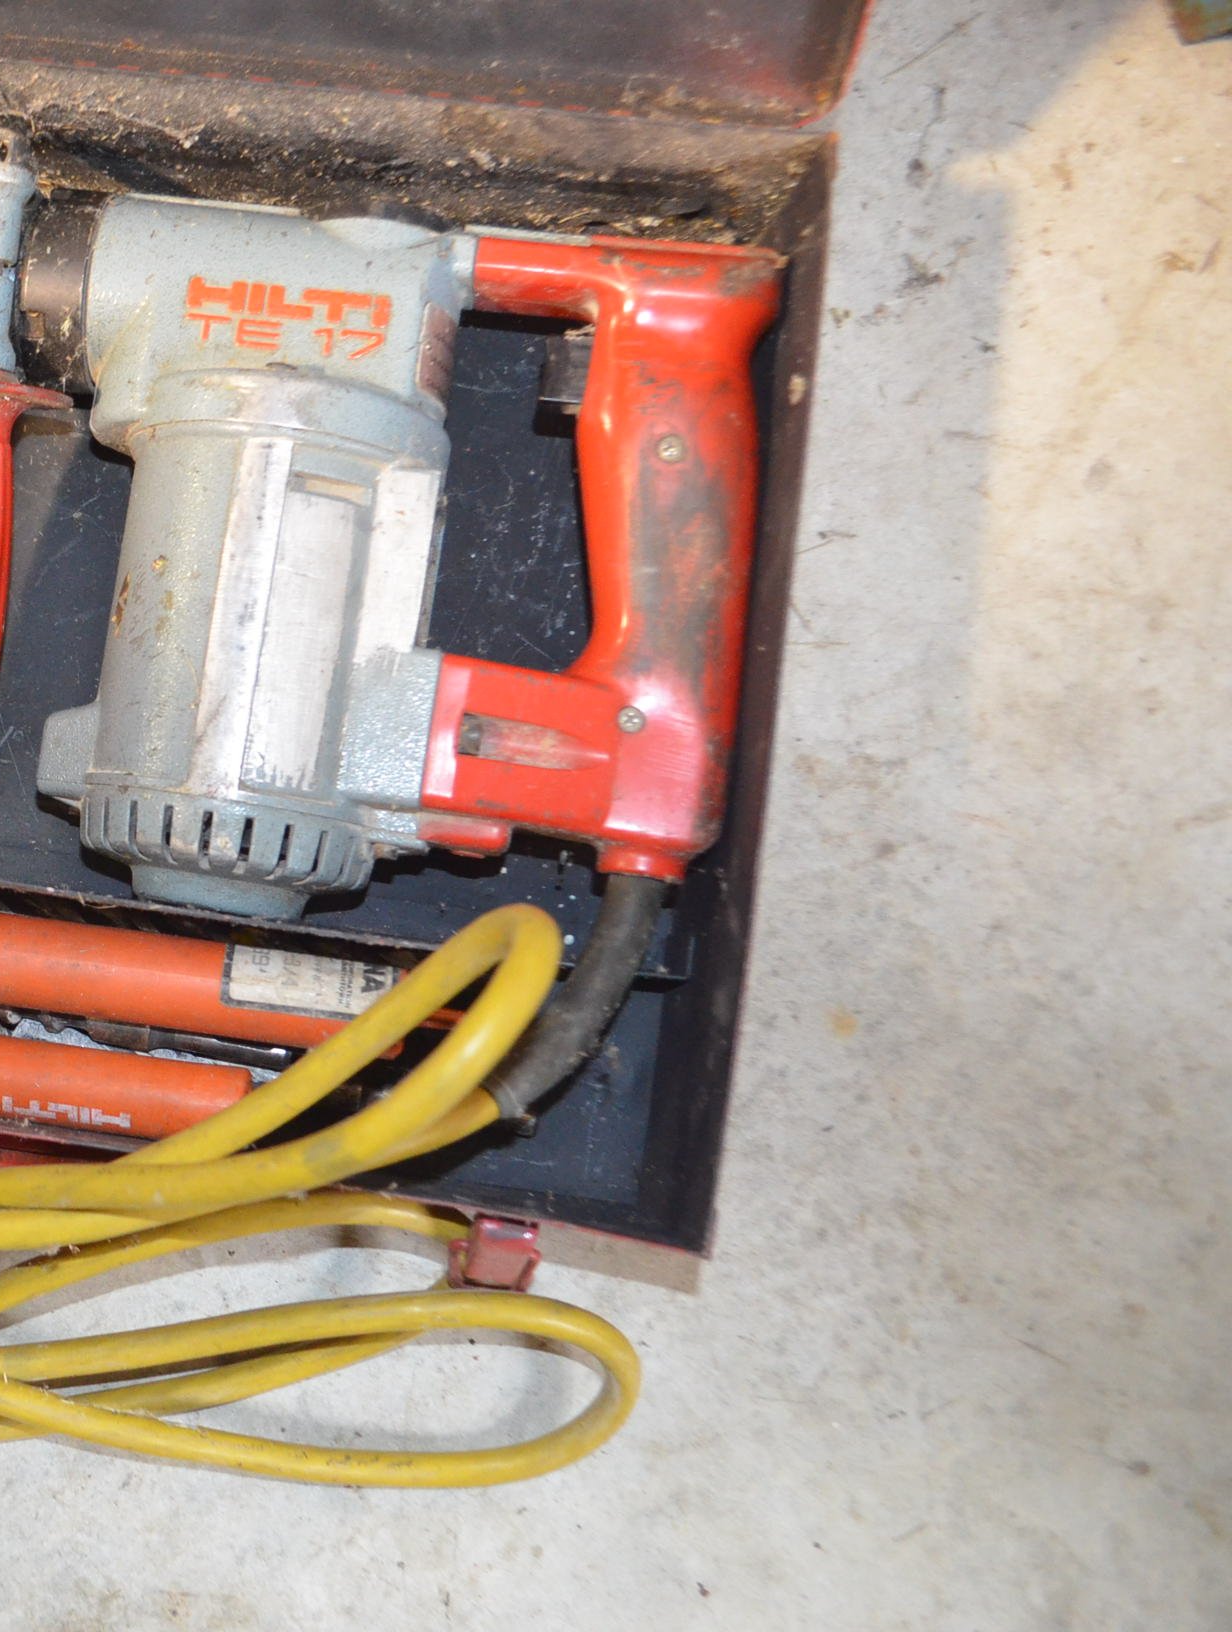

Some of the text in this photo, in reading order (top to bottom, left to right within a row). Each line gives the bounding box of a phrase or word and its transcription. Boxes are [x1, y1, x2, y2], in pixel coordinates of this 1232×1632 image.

[186, 275, 392, 328] HILTI
[184, 312, 386, 360] TE 17
[2, 1096, 131, 1129] HILTI
